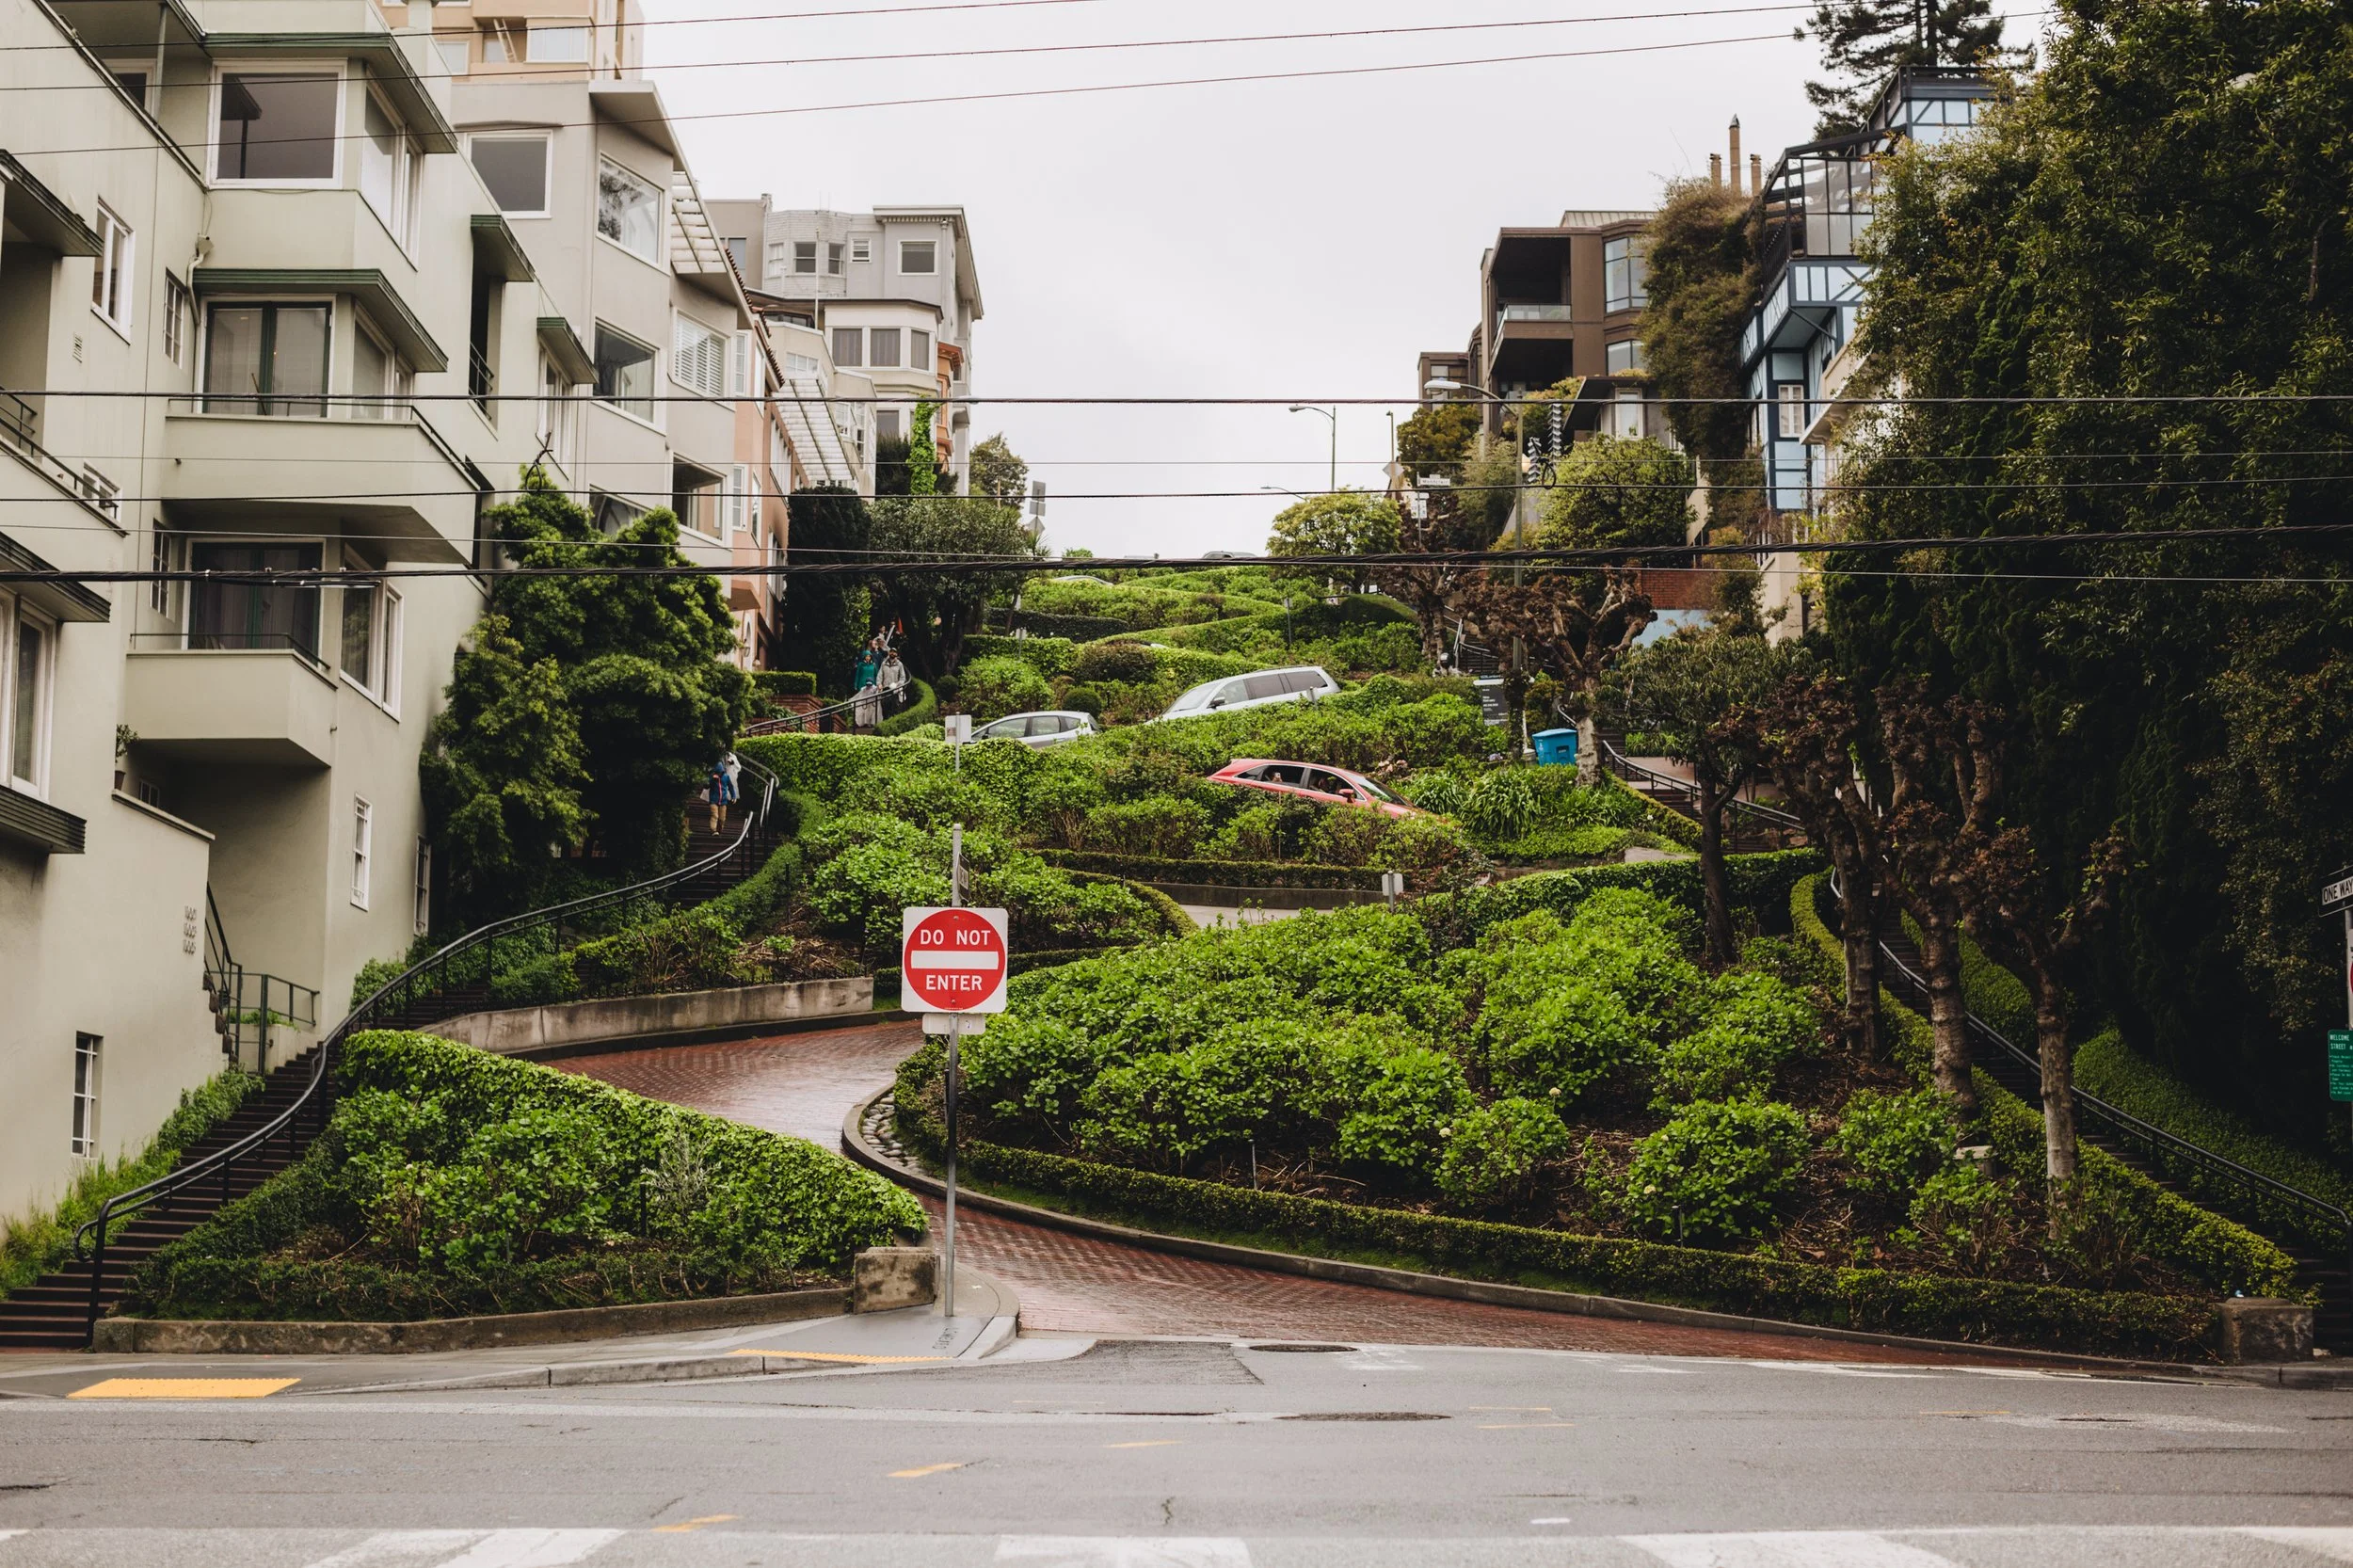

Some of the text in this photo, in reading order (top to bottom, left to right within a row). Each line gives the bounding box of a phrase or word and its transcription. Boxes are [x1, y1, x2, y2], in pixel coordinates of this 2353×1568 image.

[2324, 878, 2353, 903] ONE WAY
[920, 929, 990, 945] DO NOT
[926, 975, 983, 990] ENTER
